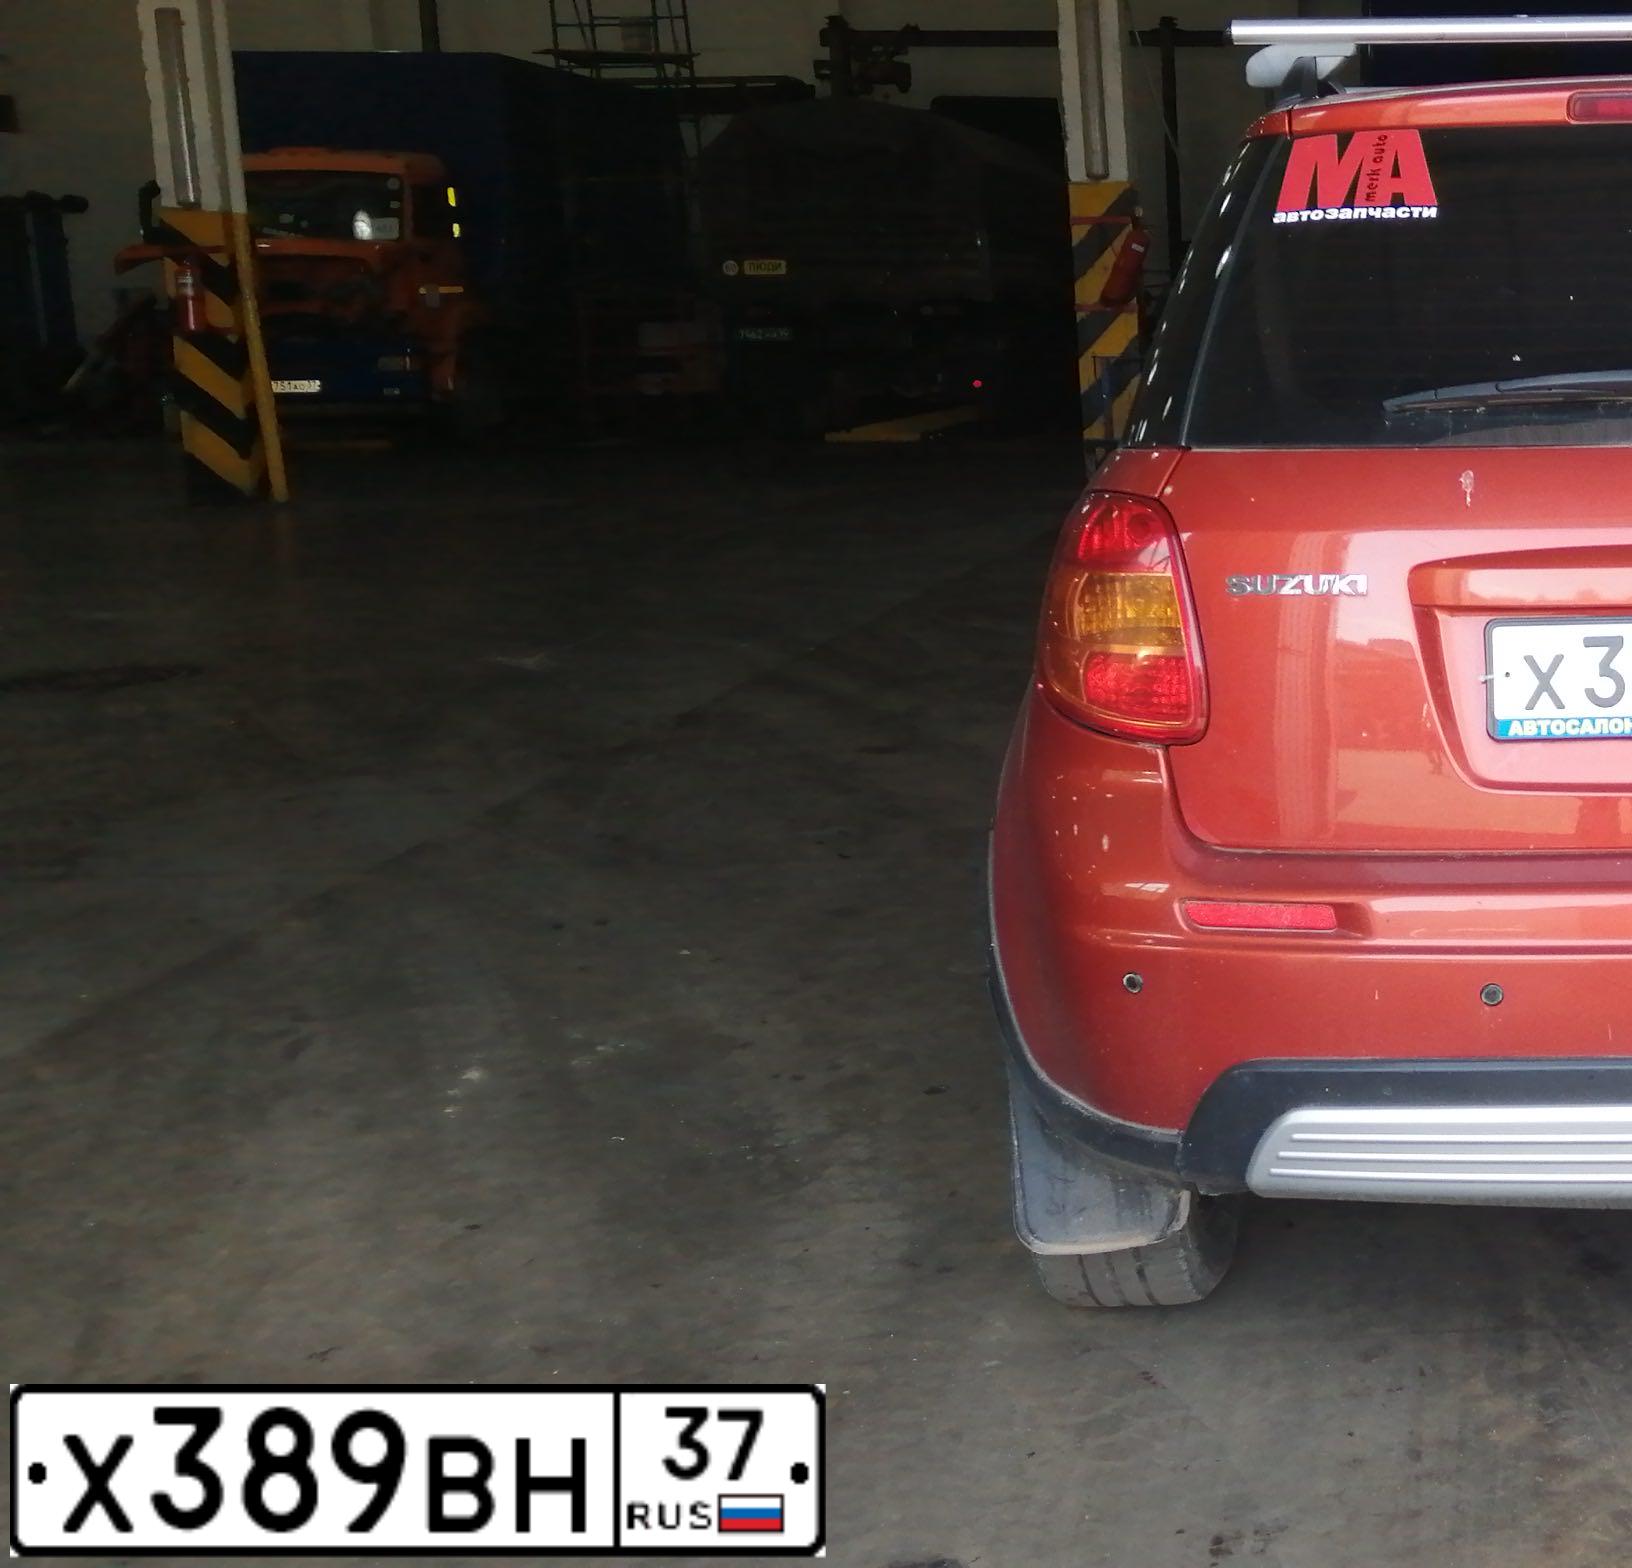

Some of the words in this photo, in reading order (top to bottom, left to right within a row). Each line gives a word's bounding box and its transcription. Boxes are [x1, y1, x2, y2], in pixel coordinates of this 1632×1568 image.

[1373, 134, 1388, 164] auto
[1272, 205, 1438, 224] автозапчасти
[1225, 574, 1368, 596] SUZUKI
